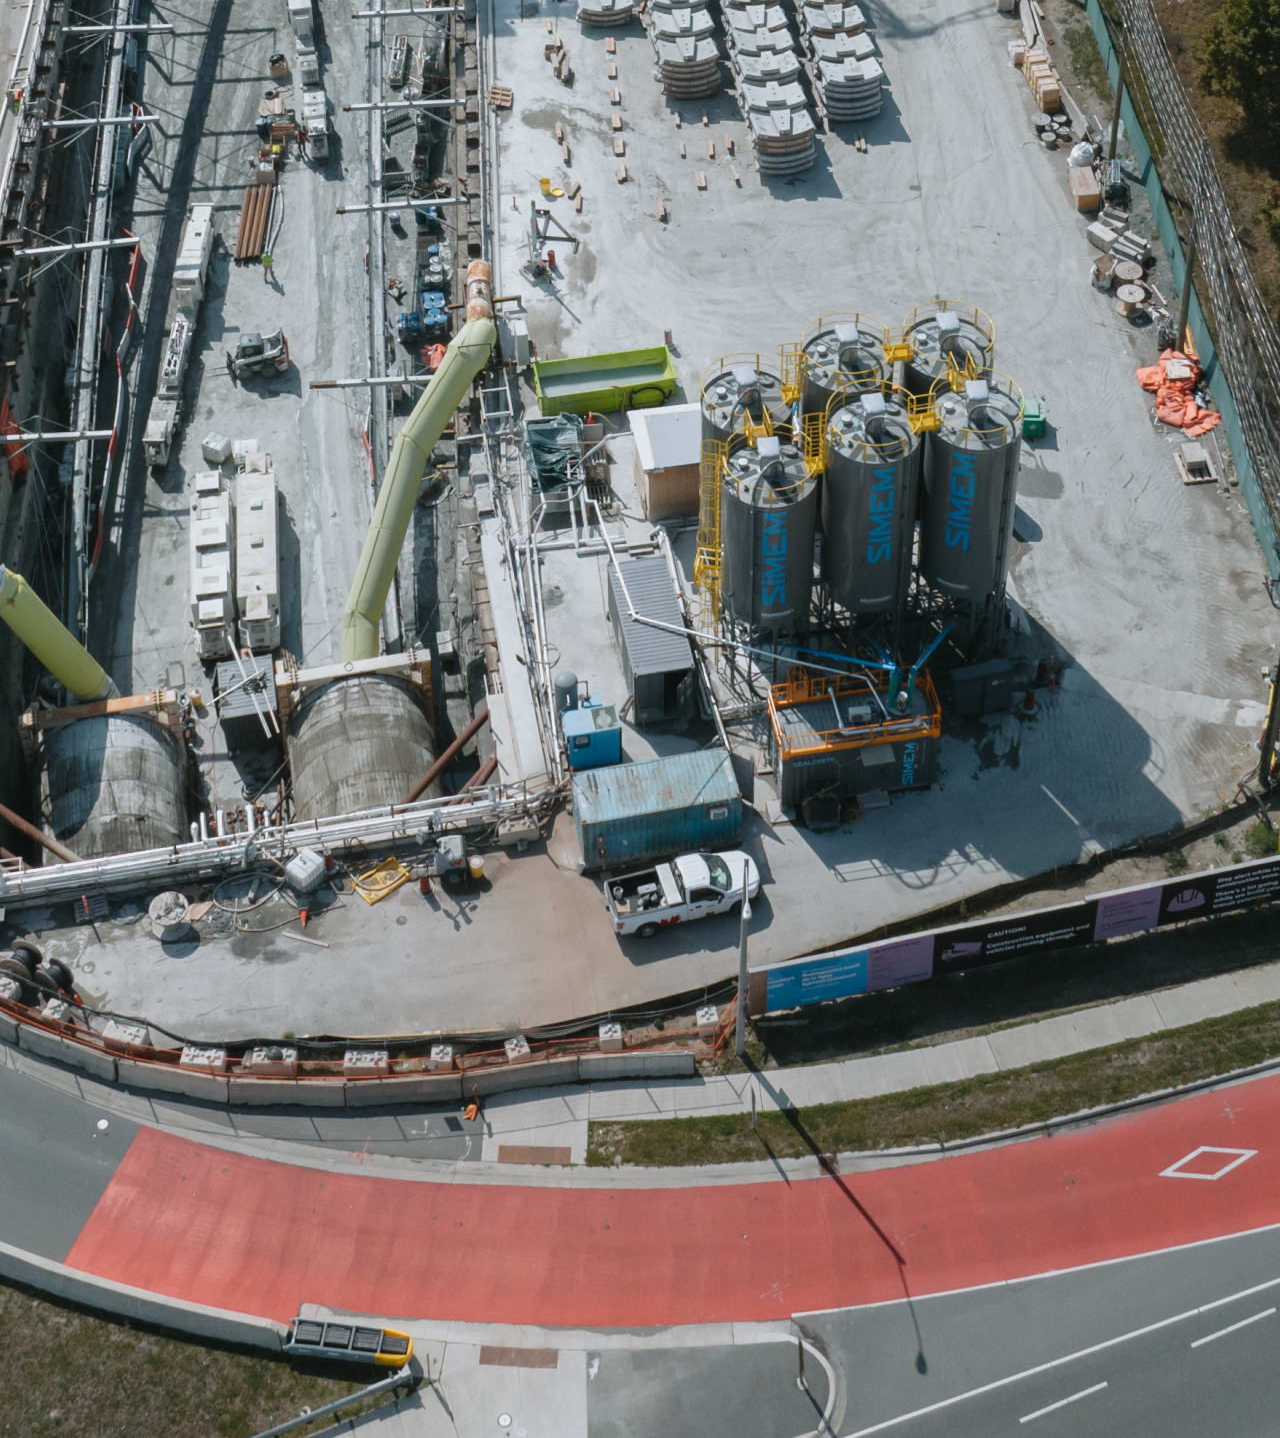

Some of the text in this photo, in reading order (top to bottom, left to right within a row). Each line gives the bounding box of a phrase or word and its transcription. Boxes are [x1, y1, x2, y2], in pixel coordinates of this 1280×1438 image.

[866, 467, 896, 565] SIMEM
[946, 453, 976, 551] SIMEM
[761, 510, 788, 606] SIMEM
[902, 742, 916, 785] SIMEM
[986, 945, 1015, 954] vehicles
[1016, 940, 1044, 949] passing
[987, 936, 1034, 948] Construction
[1035, 928, 1075, 939] equipment
[988, 926, 1026, 938] CAUTION!
